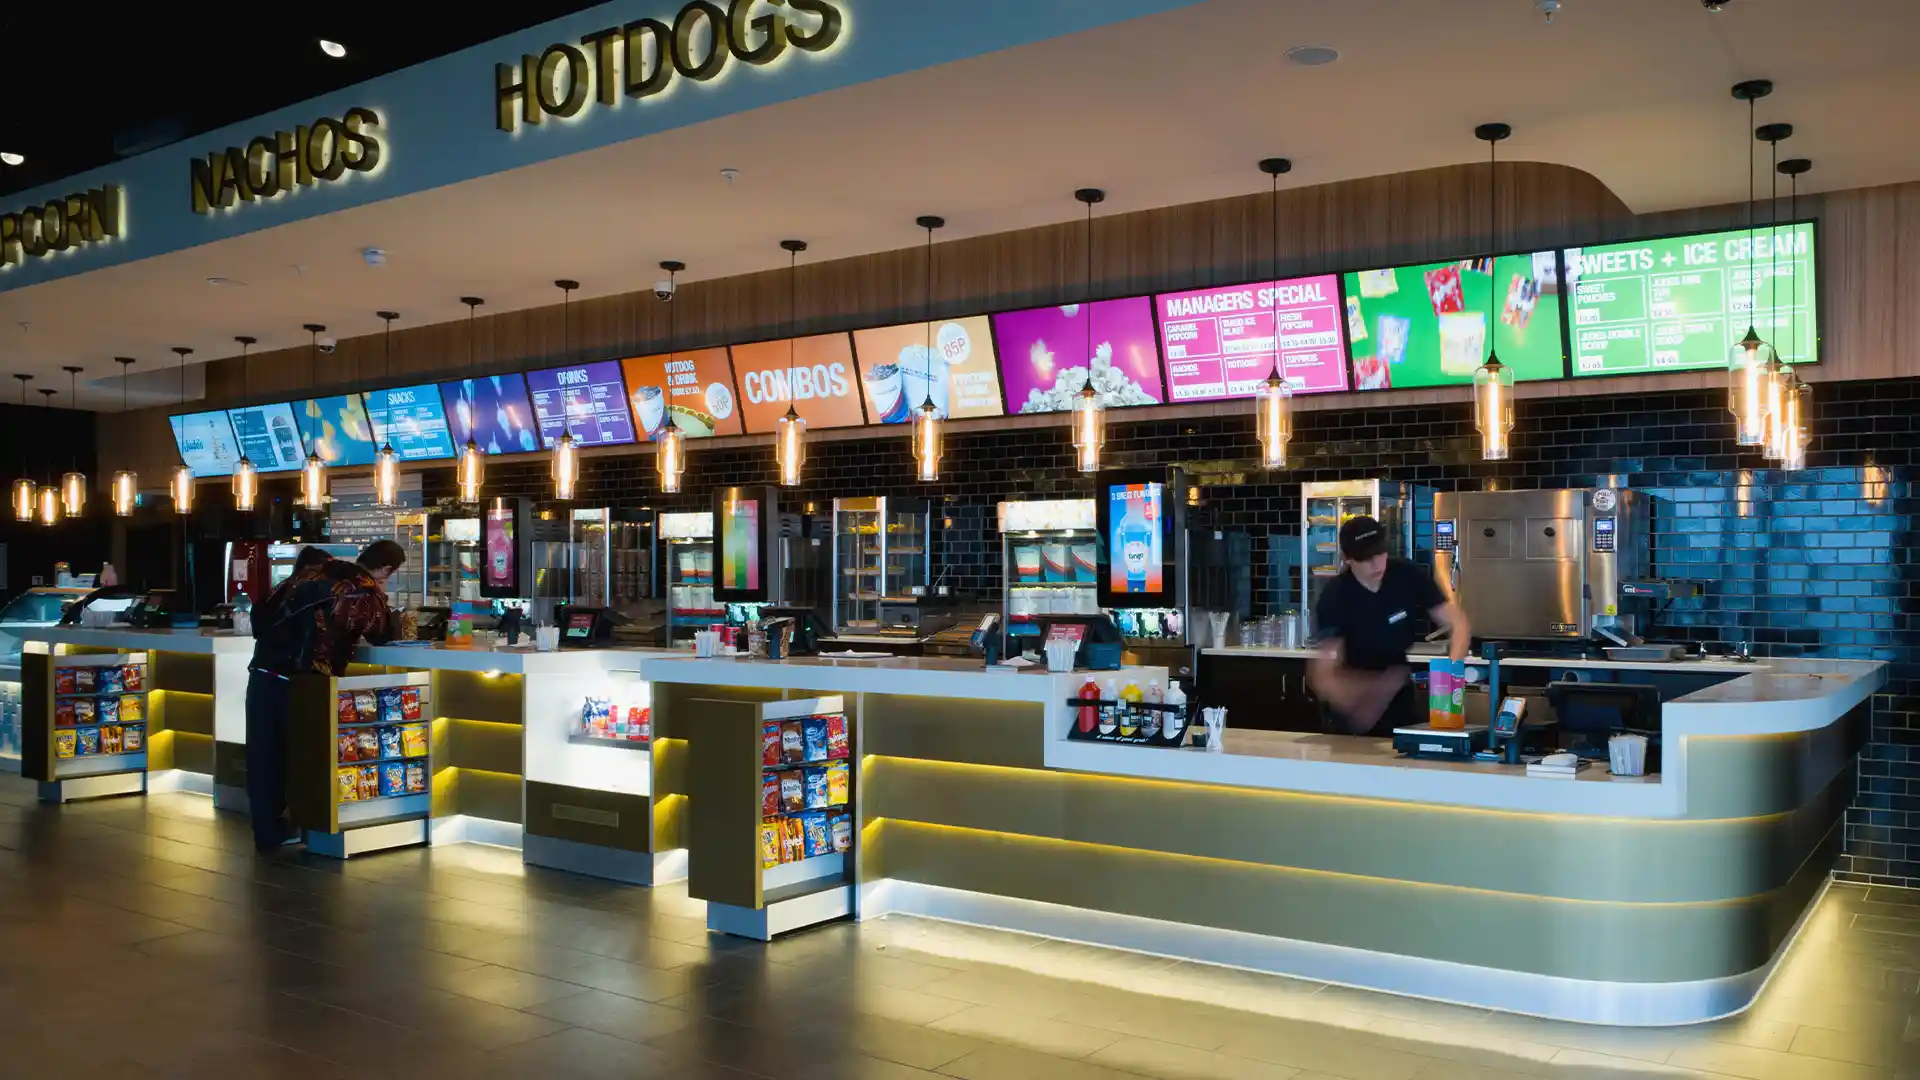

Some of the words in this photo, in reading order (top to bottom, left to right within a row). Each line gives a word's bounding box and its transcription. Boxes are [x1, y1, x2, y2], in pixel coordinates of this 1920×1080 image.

[495, 0, 842, 132] HOTDOGS
[190, 107, 381, 214] NACHOS
[1661, 251, 1676, 267] +
[1684, 242, 1718, 266] ICE
[1725, 231, 1808, 261] CREAM
[1576, 283, 1605, 295] SWEET
[1167, 290, 1254, 317] MANAGERS
[1257, 283, 1327, 308] SPECIAL
[664, 360, 696, 374] HOTDOG
[557, 369, 589, 385] DRINKS
[675, 372, 698, 385] DRINK
[745, 362, 849, 404] COMBOS
[388, 391, 416, 405] SNACKS
[1112, 493, 1117, 501] 3
